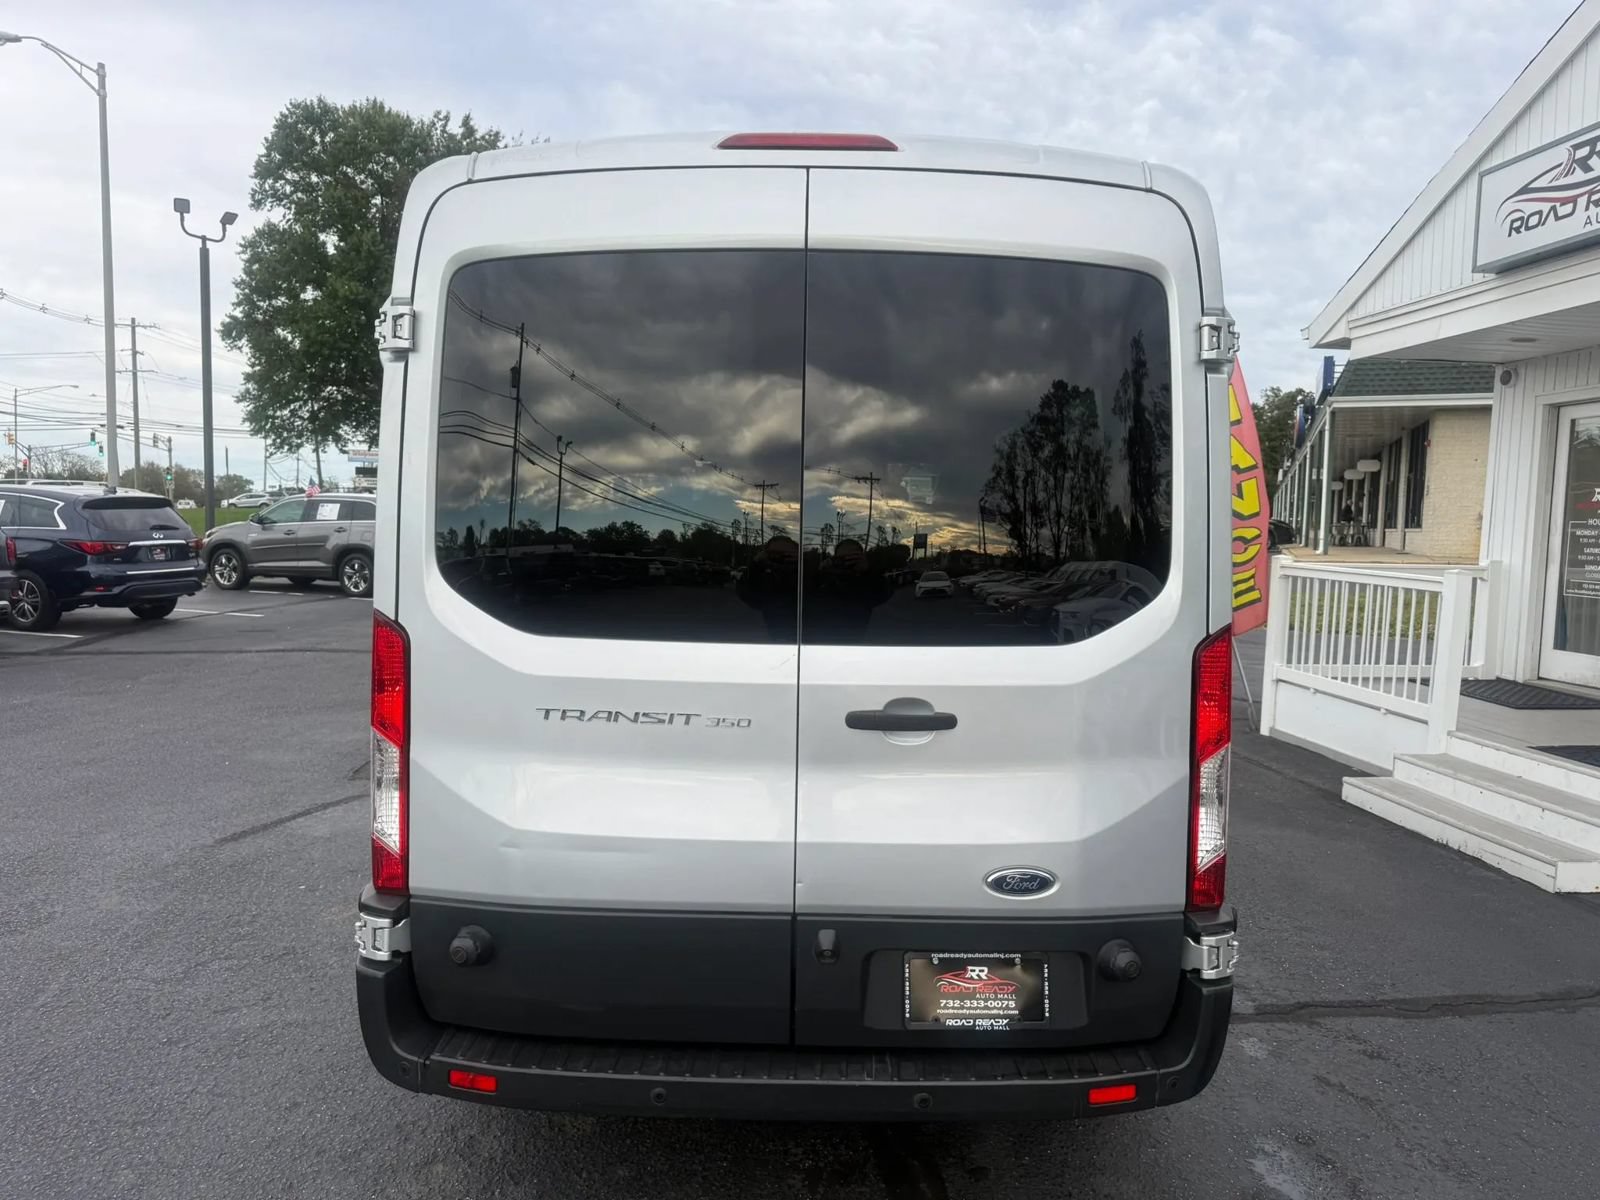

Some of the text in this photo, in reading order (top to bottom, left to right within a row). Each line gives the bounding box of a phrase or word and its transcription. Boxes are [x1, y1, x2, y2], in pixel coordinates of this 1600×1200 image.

[1507, 199, 1577, 237] ROAD
[535, 707, 752, 728] TRANSIT 350
[1002, 874, 1040, 890] Ford
[965, 966, 989, 980] RR
[940, 985, 1016, 993] ROAD READY
